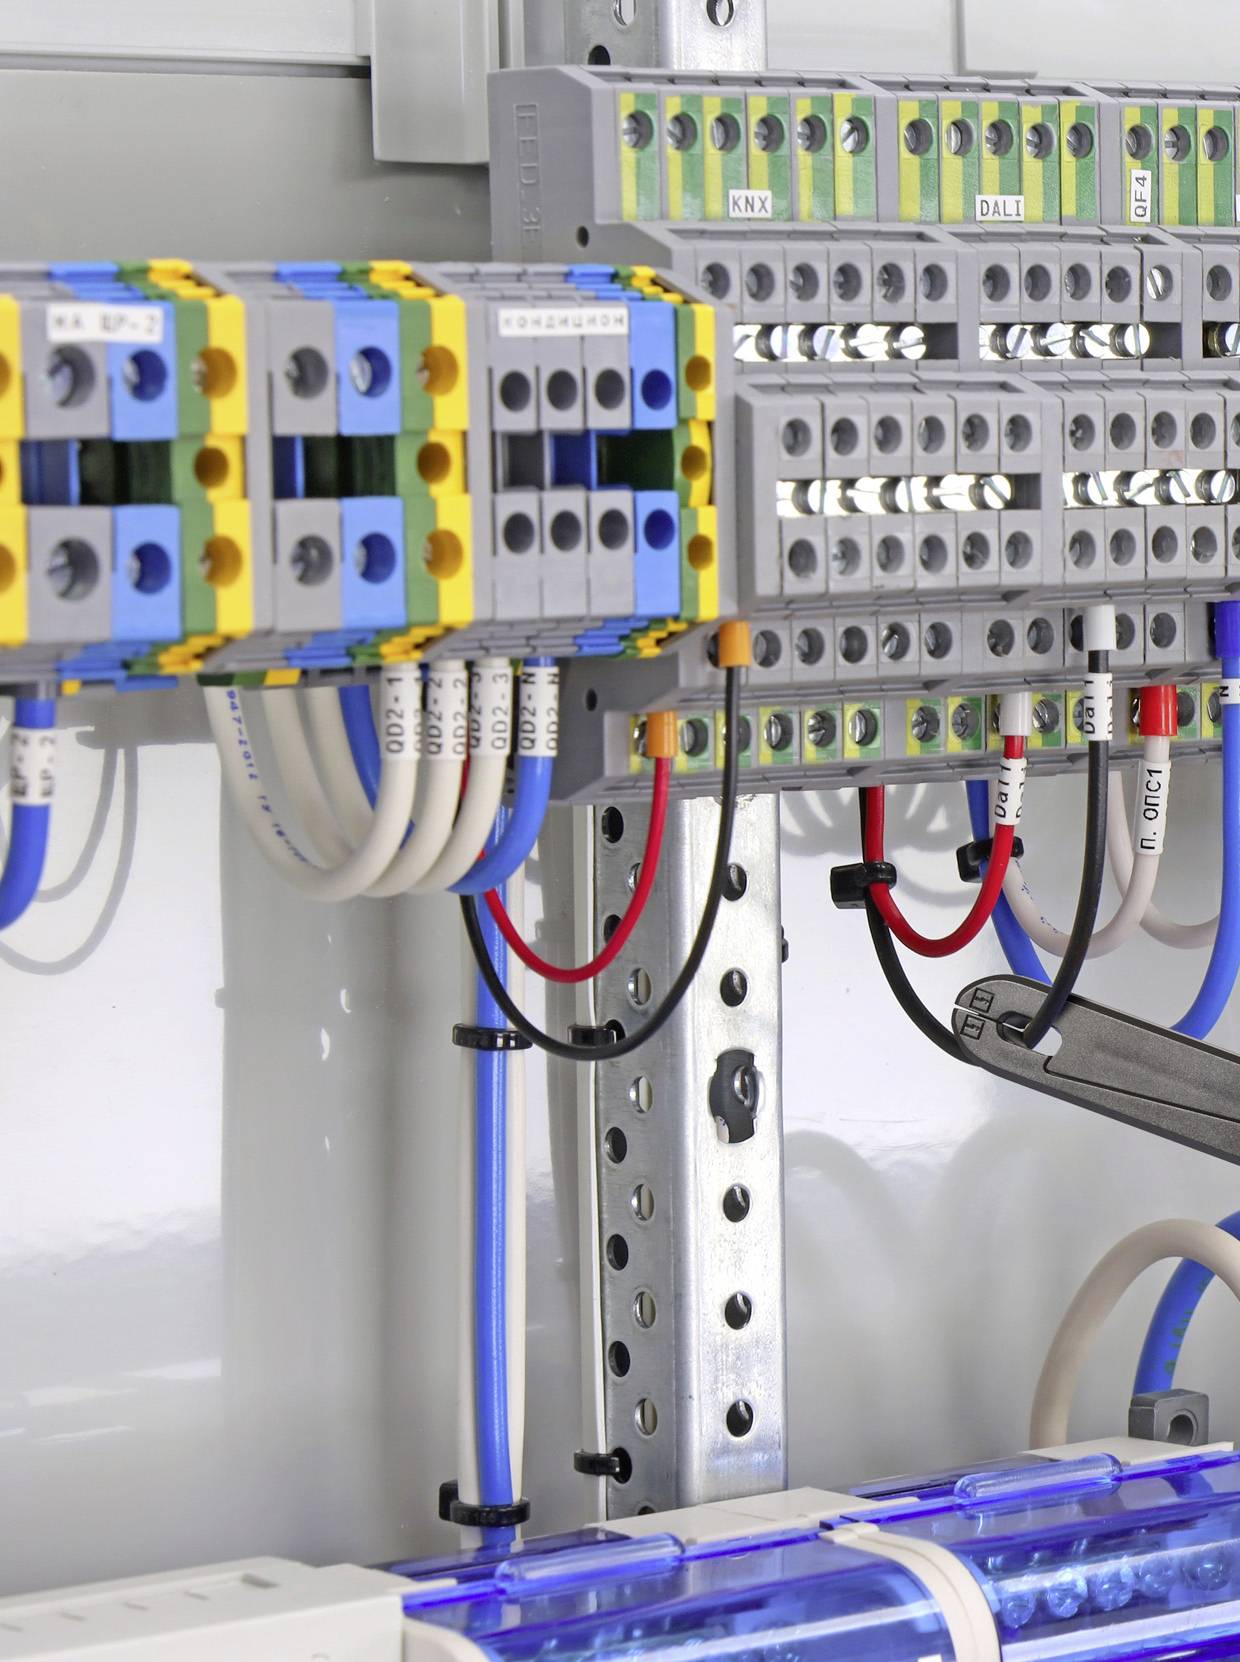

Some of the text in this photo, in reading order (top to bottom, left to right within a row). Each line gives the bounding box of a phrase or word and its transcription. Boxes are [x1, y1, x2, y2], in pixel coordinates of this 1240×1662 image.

[731, 192, 769, 214] KNX
[980, 198, 1023, 218] DALI
[1133, 175, 1149, 218] QF4
[386, 676, 405, 755] QD2-1
[427, 673, 443, 756] QD2-2
[491, 672, 509, 751] QD2-3
[519, 672, 537, 751] QD2-N
